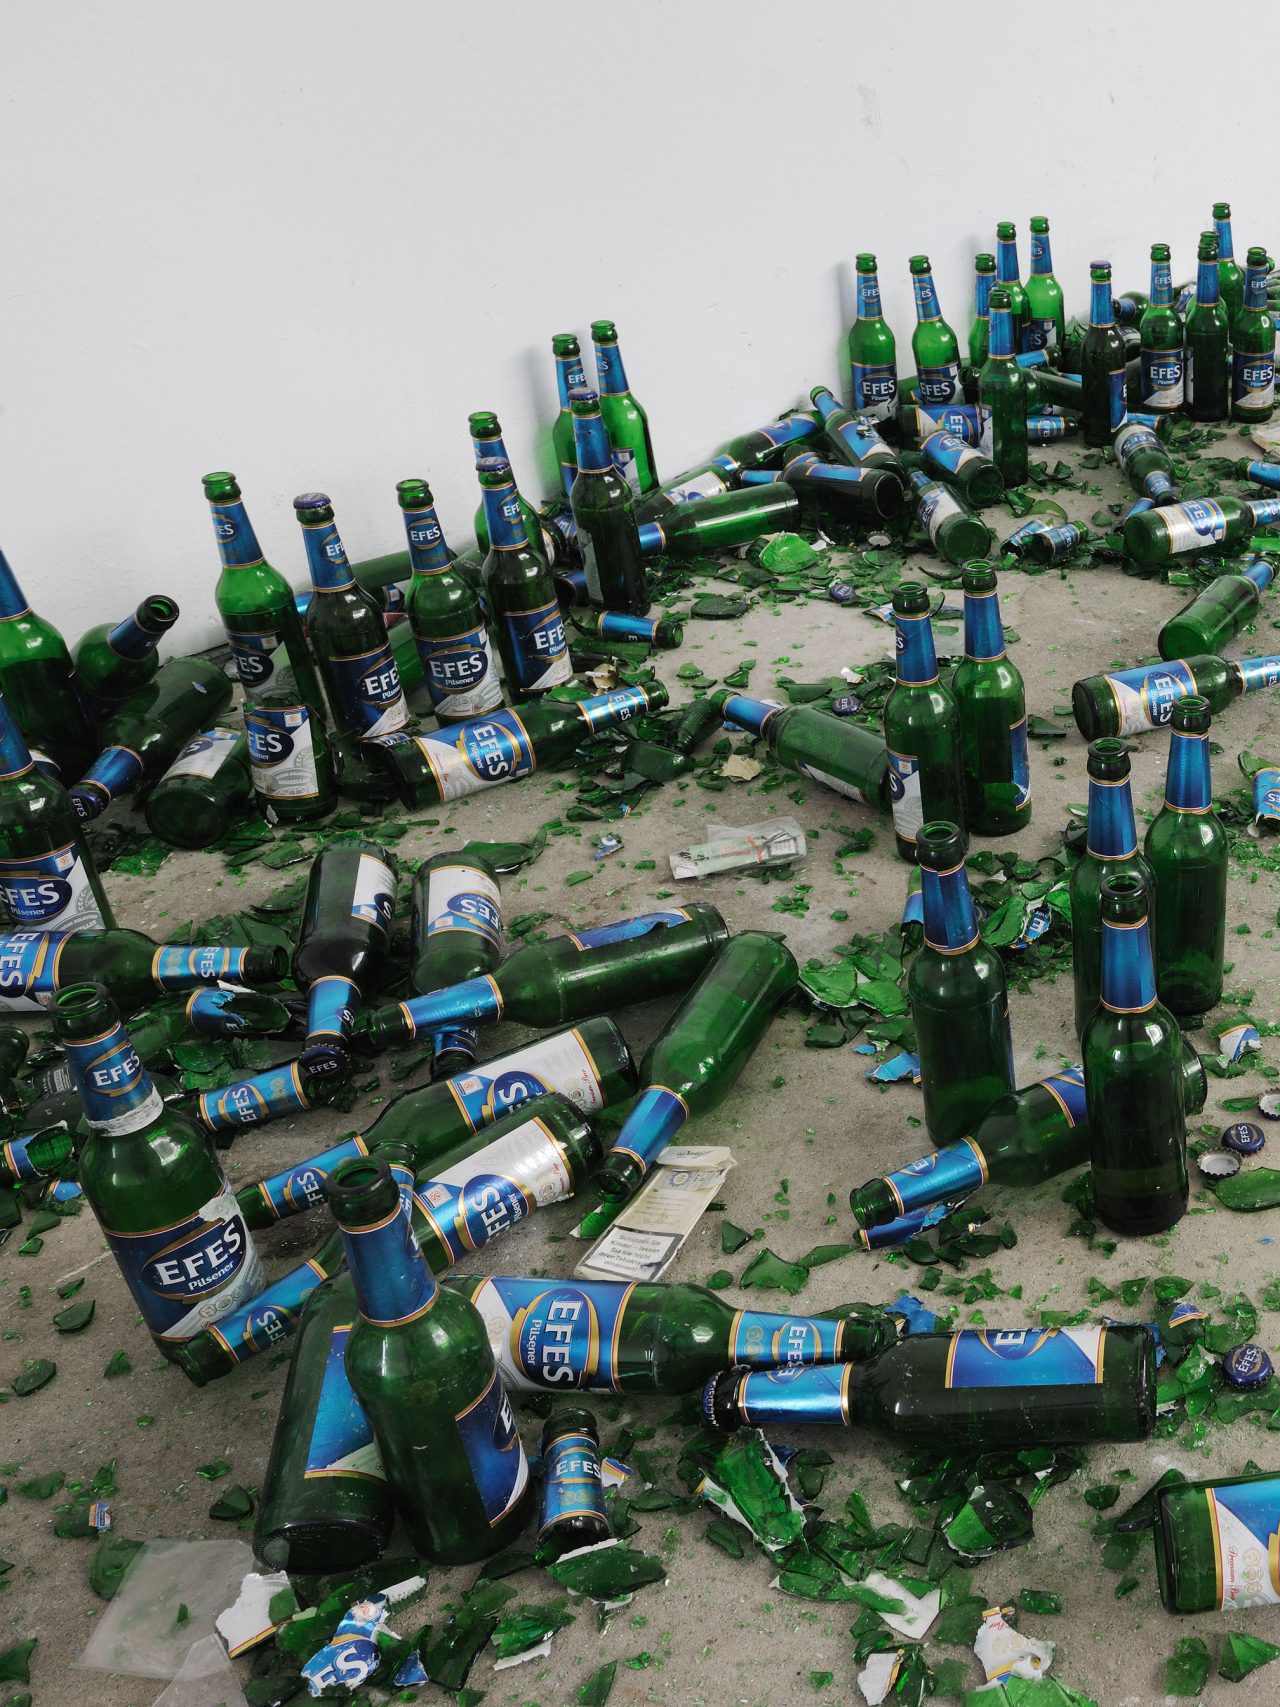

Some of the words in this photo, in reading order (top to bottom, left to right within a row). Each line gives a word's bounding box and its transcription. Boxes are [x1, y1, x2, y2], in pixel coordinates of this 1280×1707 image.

[1149, 365, 1181, 379] EFES
[1243, 366, 1273, 382] EFES
[861, 379, 896, 395] EFES
[410, 526, 441, 543] EFES
[429, 655, 484, 681] EFES
[613, 694, 632, 723] EFES
[472, 723, 511, 778] EFES
[72, 797, 88, 819] EFES
[200, 946, 221, 979] EFES
[93, 1050, 140, 1088] EFES
[308, 1058, 339, 1075] EFES
[233, 1086, 258, 1123] EFES
[1238, 1123, 1253, 1144] EFES
[470, 1186, 512, 1243] FES
[154, 1222, 243, 1287] EFES
[188, 1260, 235, 1291] Pilsener
[526, 1318, 542, 1367] Pilsener
[541, 1299, 585, 1384] EFES
[1234, 1347, 1258, 1373] EFES
[555, 1459, 602, 1478] EFES
